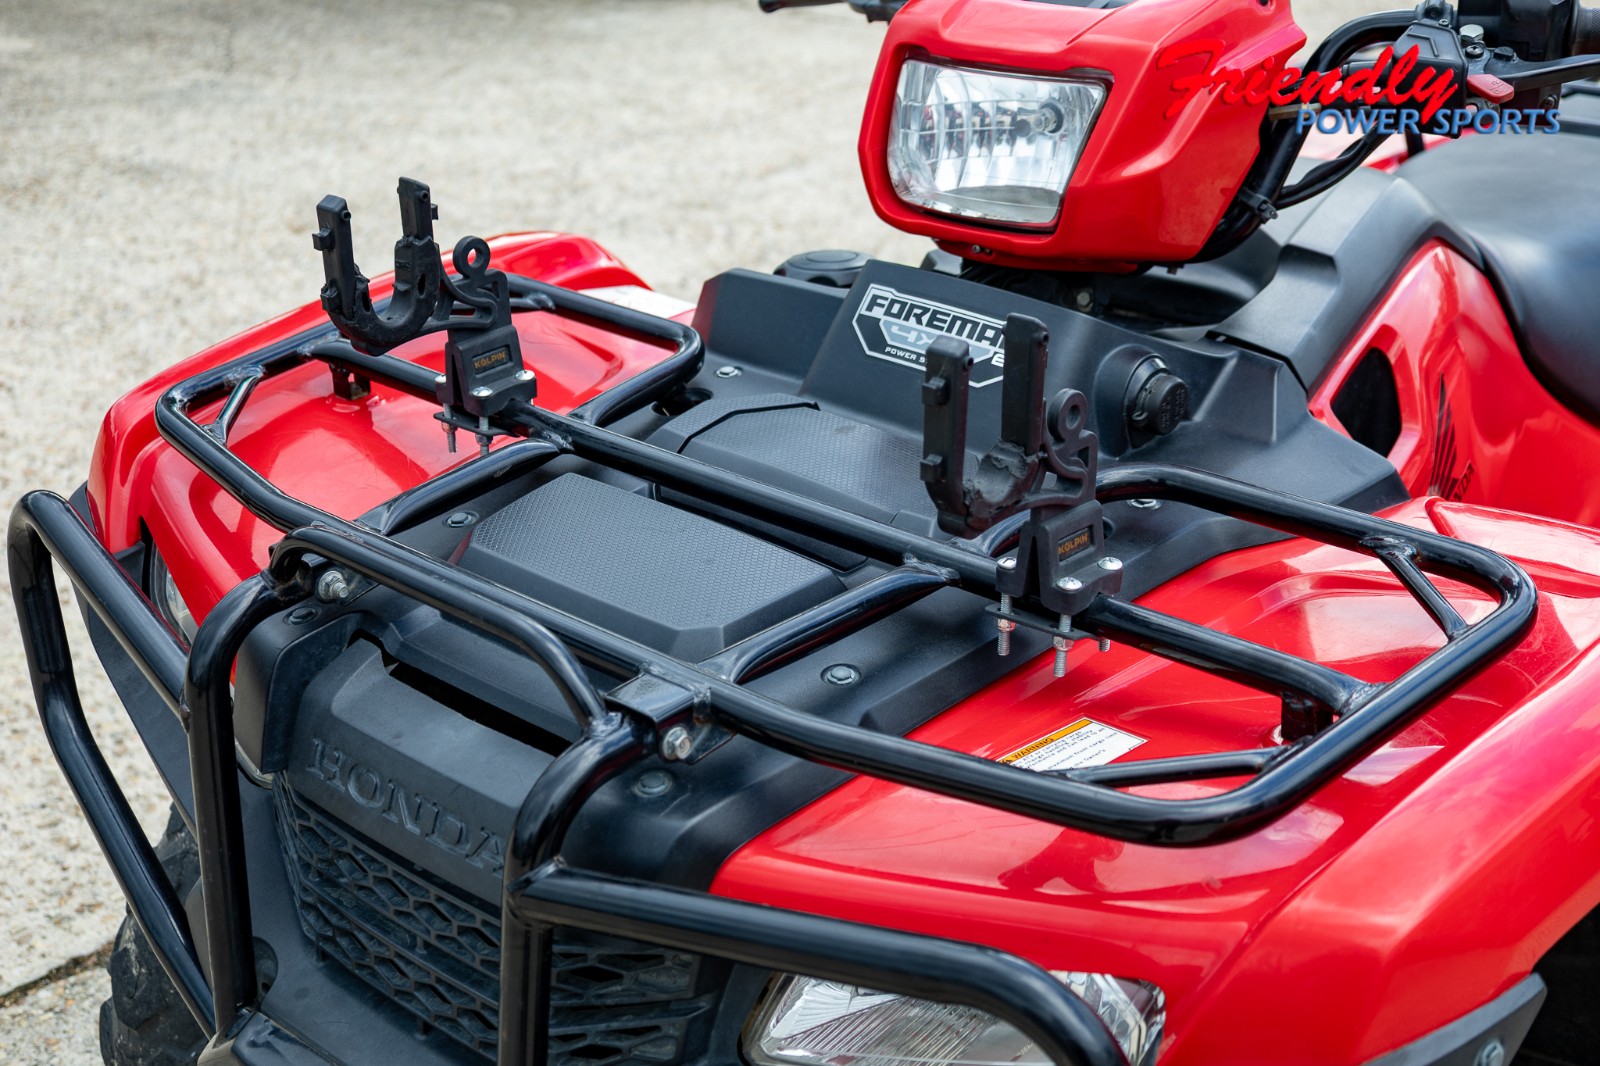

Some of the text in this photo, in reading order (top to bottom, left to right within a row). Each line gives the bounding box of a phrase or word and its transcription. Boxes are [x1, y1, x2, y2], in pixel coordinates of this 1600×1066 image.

[865, 294, 1006, 351] FOREMA
[474, 351, 507, 369] KOLPIN
[884, 346, 916, 361] POWER
[1058, 532, 1089, 555] KOLPIN
[1011, 737, 1054, 759] WARNING
[306, 737, 504, 880] HONDA
